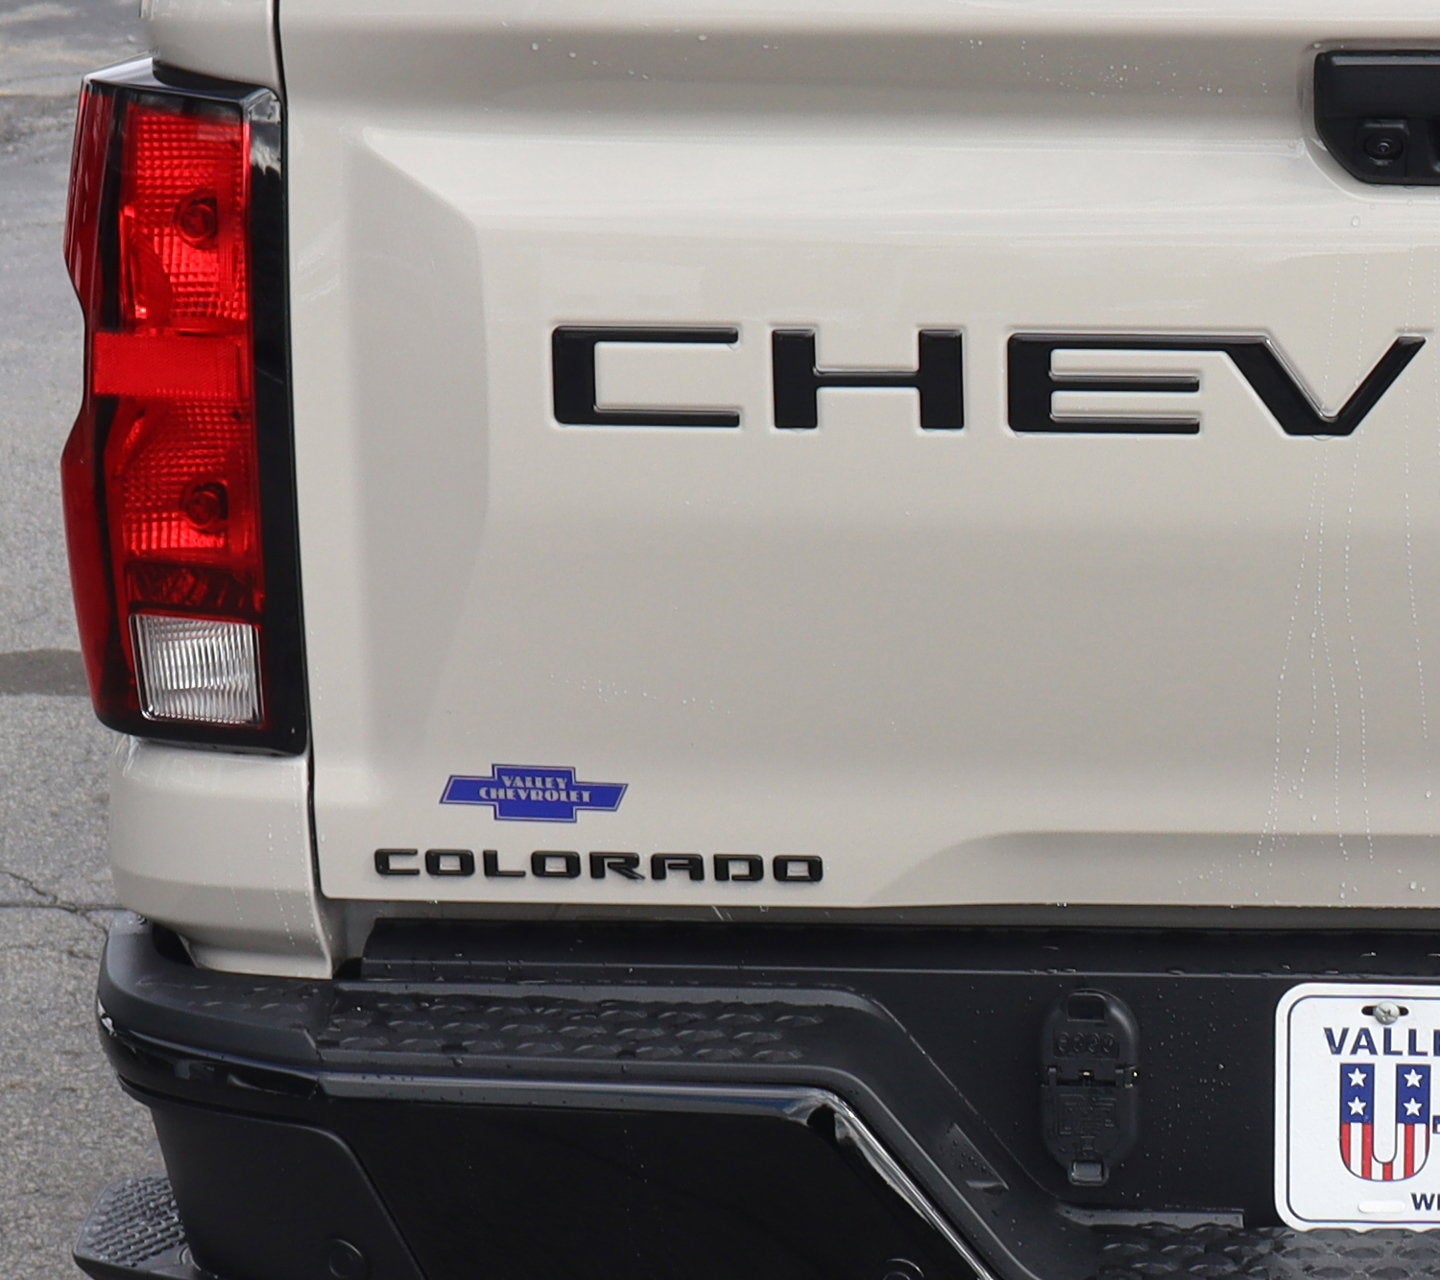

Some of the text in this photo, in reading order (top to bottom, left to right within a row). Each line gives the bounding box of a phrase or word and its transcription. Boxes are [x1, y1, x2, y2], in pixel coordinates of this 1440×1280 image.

[501, 775, 567, 790] VALLEY
[479, 786, 592, 803] CHEVROLET
[374, 848, 823, 883] COLORADO
